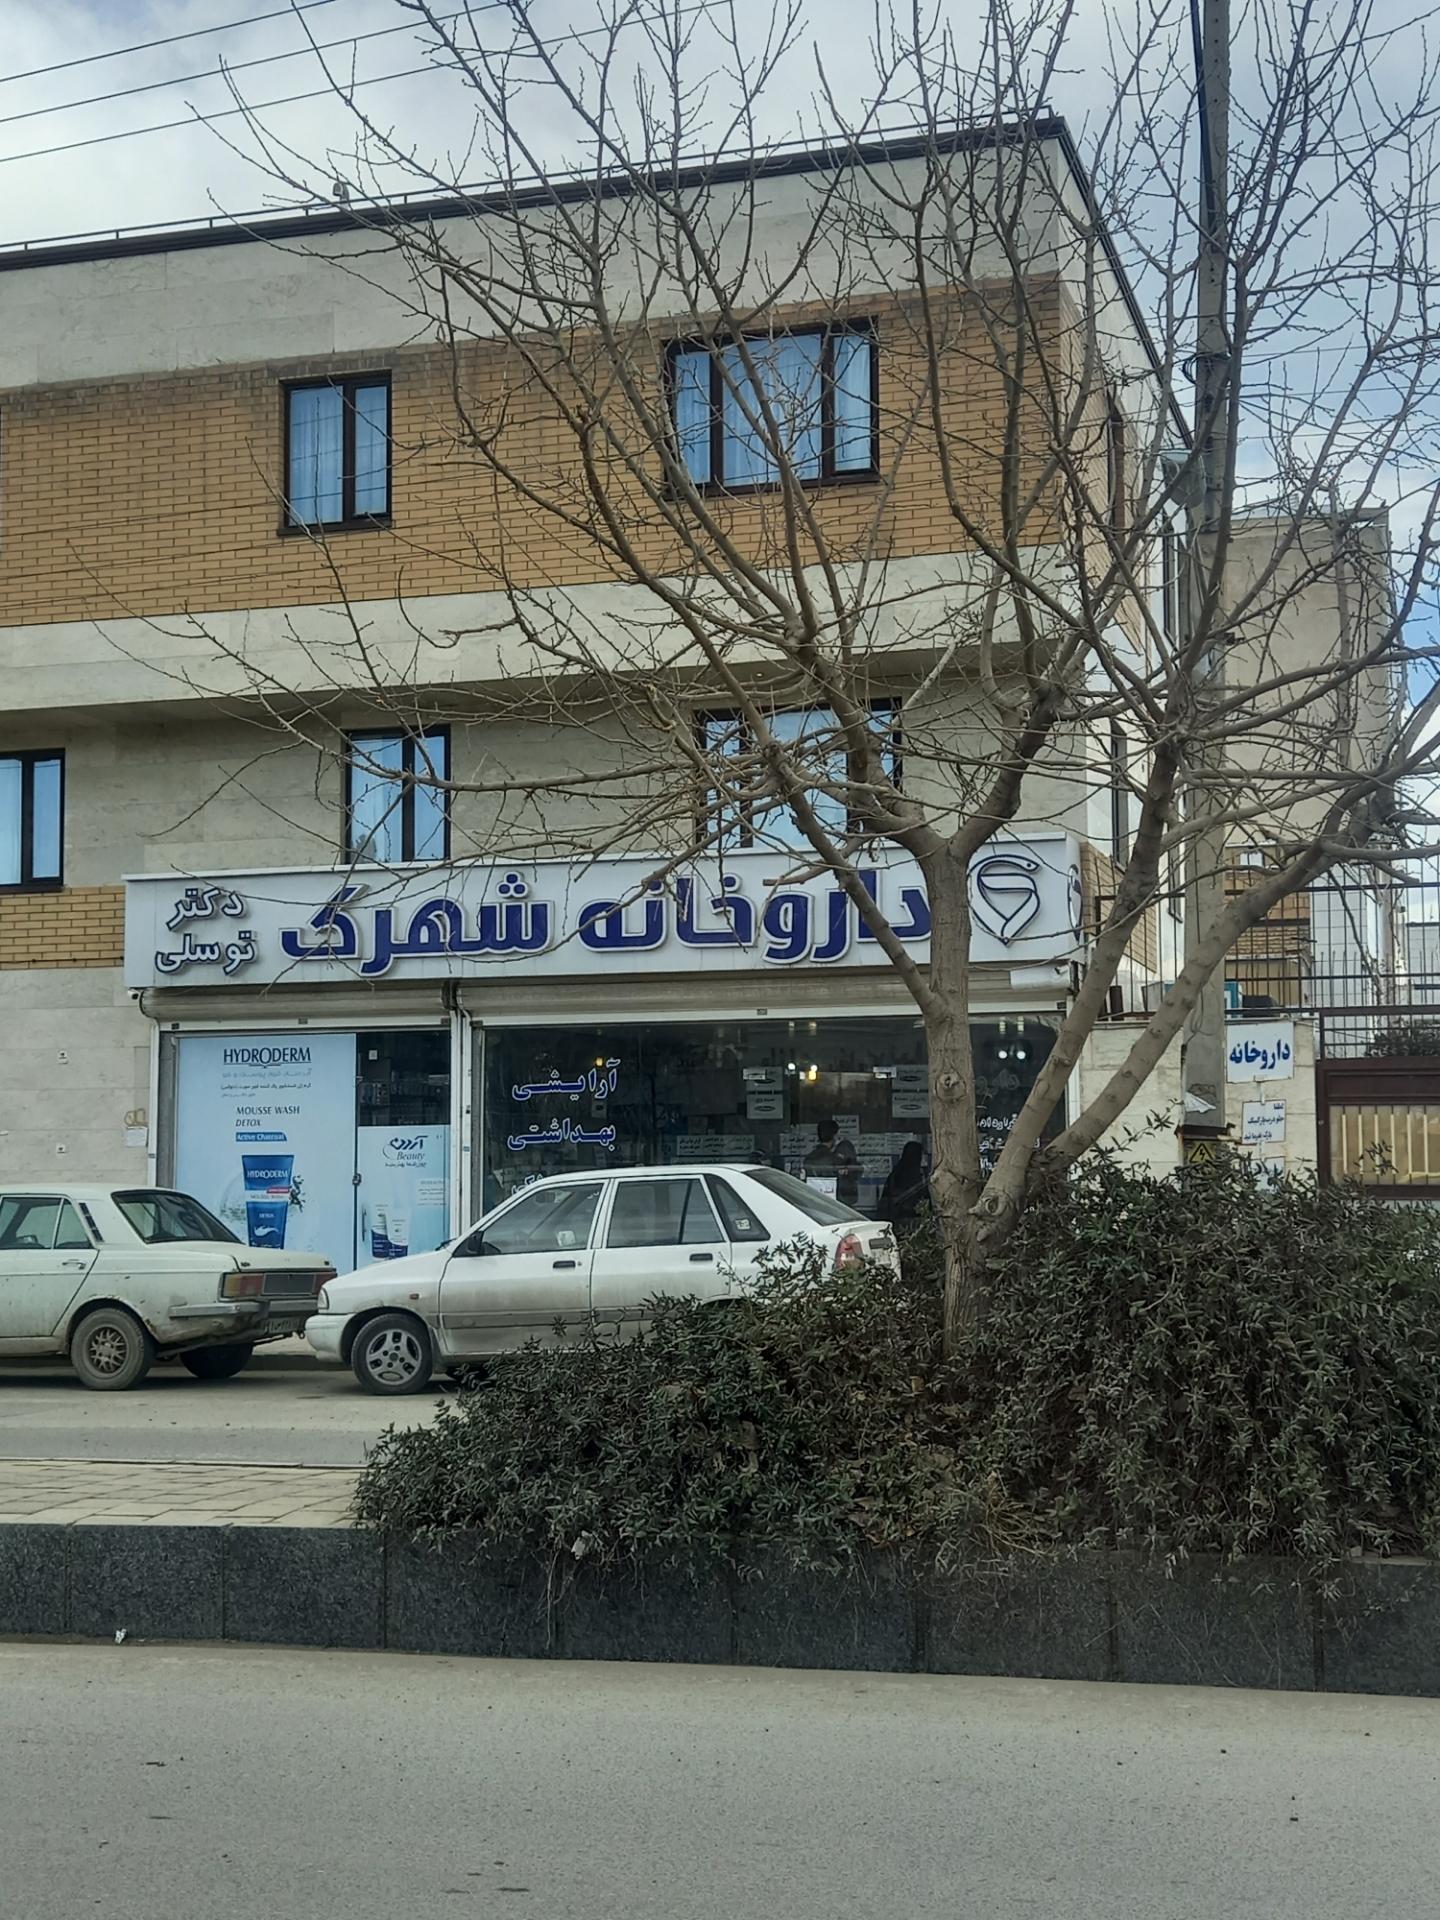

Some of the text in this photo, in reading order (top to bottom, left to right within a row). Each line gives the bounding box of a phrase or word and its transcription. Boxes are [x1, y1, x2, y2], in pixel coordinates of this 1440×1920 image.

[165, 887, 247, 931] دکتر
[278, 868, 932, 977] داروخانه شهرک
[155, 930, 258, 976] توسلی
[223, 1047, 312, 1065] HYDRODERM
[1229, 1039, 1291, 1070] داروخانه
[511, 1057, 621, 1101] آرایشی
[235, 1119, 261, 1127] DETOX
[236, 1105, 300, 1115] MOUSSE WASH
[507, 1118, 616, 1152] بهداشتی
[396, 1151, 426, 1161] Beauty
[246, 1169, 288, 1180] HYDRODERM
